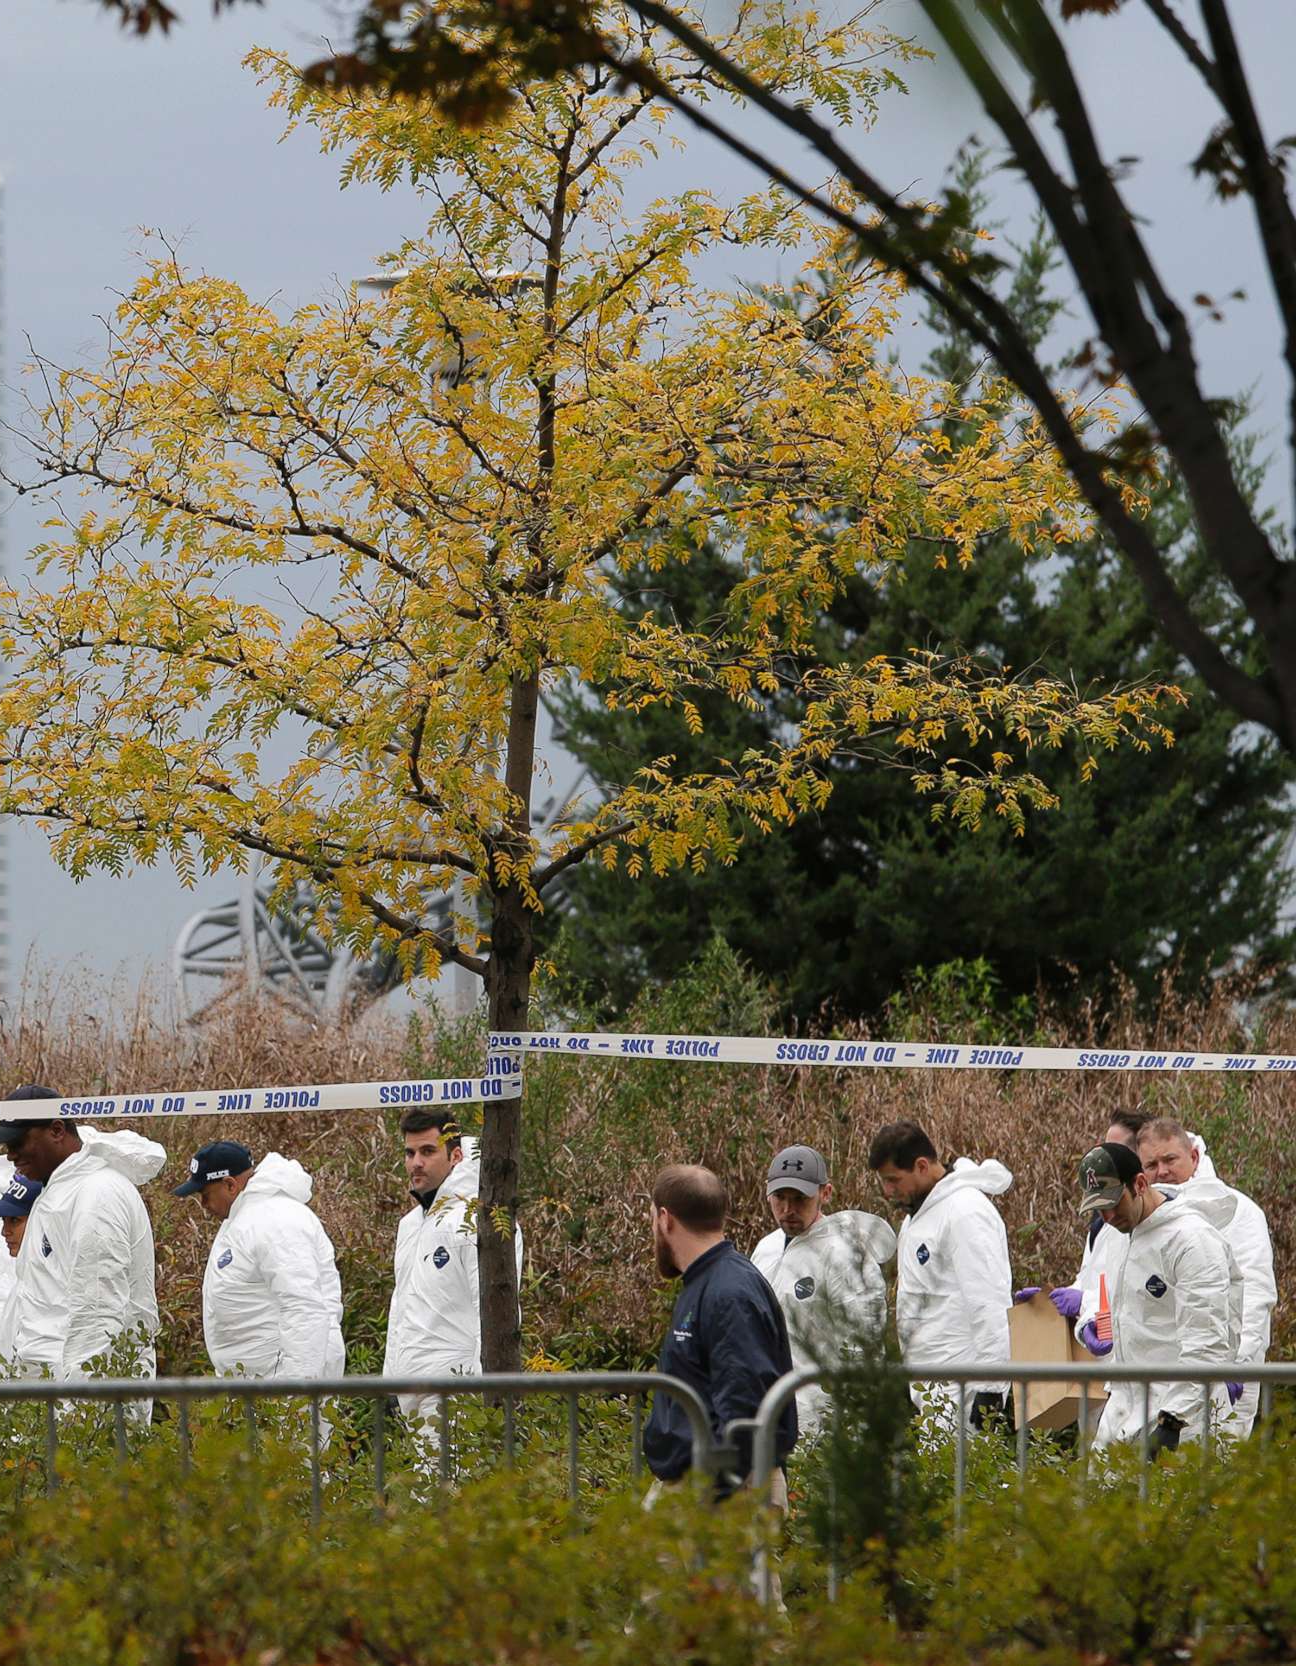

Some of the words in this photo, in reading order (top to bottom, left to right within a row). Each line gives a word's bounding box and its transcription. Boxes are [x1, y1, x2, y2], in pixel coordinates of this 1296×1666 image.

[621, 1039, 655, 1054] LINE
[666, 1040, 720, 1057] POLICE
[776, 1043, 830, 1061] CROSS
[834, 1045, 867, 1062] NOT
[873, 1046, 896, 1062] DO
[925, 1048, 959, 1064] LINE
[968, 1049, 1024, 1065] POLICE
[1077, 1053, 1130, 1067] CROSS
[1134, 1055, 1167, 1068] NOT
[1171, 1056, 1195, 1069] DO
[1223, 1058, 1256, 1069] LINE
[379, 1083, 434, 1103] CROSS
[441, 1080, 472, 1100] NOT
[480, 1078, 502, 1097] DO
[121, 1099, 155, 1114] NOT
[162, 1097, 185, 1112] DO
[217, 1094, 252, 1111] LINE
[264, 1090, 320, 1109] POLICE
[59, 1101, 116, 1116] CROSS
